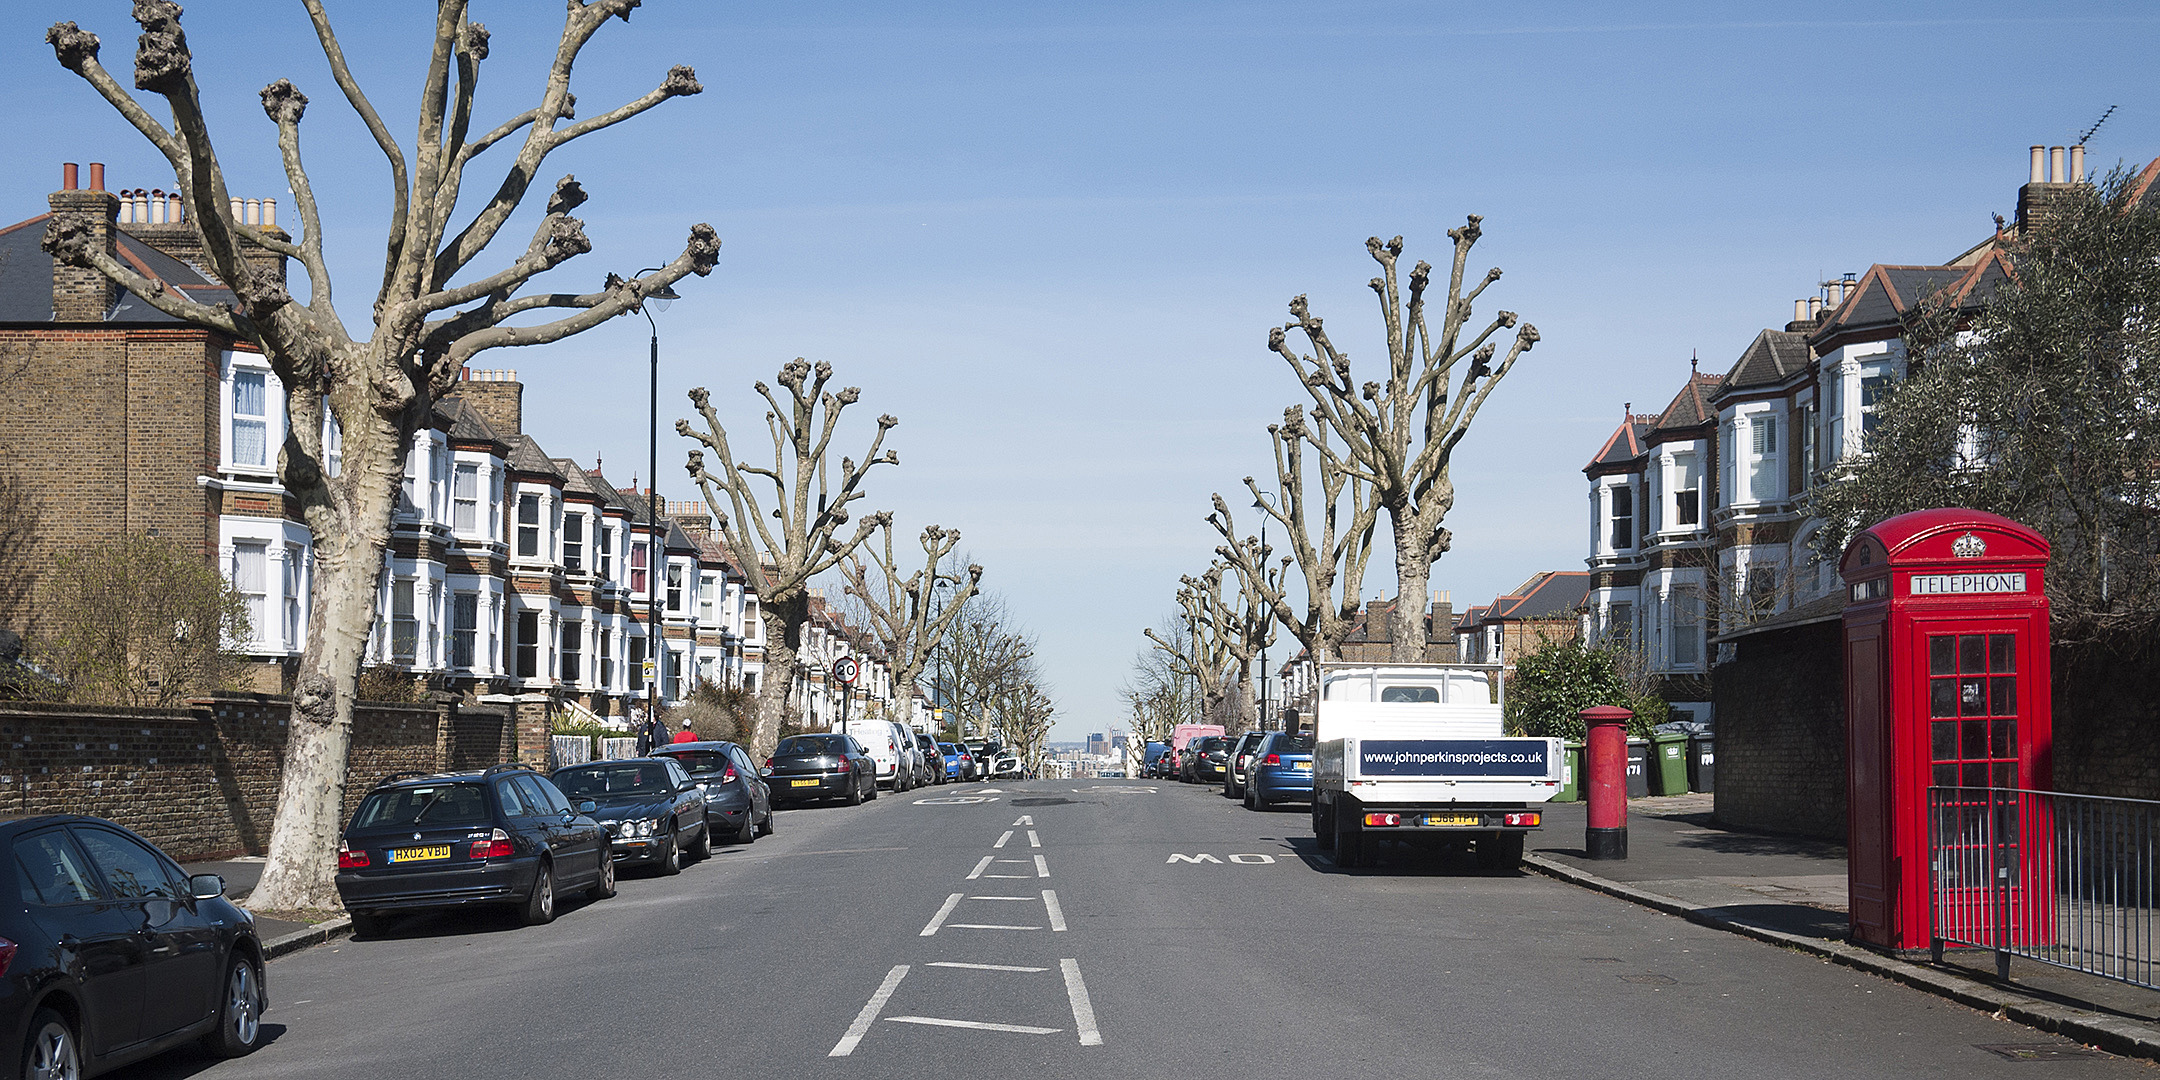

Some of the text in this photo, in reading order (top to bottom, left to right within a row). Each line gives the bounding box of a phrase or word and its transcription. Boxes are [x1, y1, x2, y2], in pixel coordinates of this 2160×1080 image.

[1915, 574, 2022, 593] TELEPHONE
[837, 664, 855, 676] 20
[1364, 751, 1542, 766] www.johnperkinsprojects.co.uk
[1429, 813, 1476, 823] LJ66 TPV
[395, 845, 449, 860] HX02 VBD
